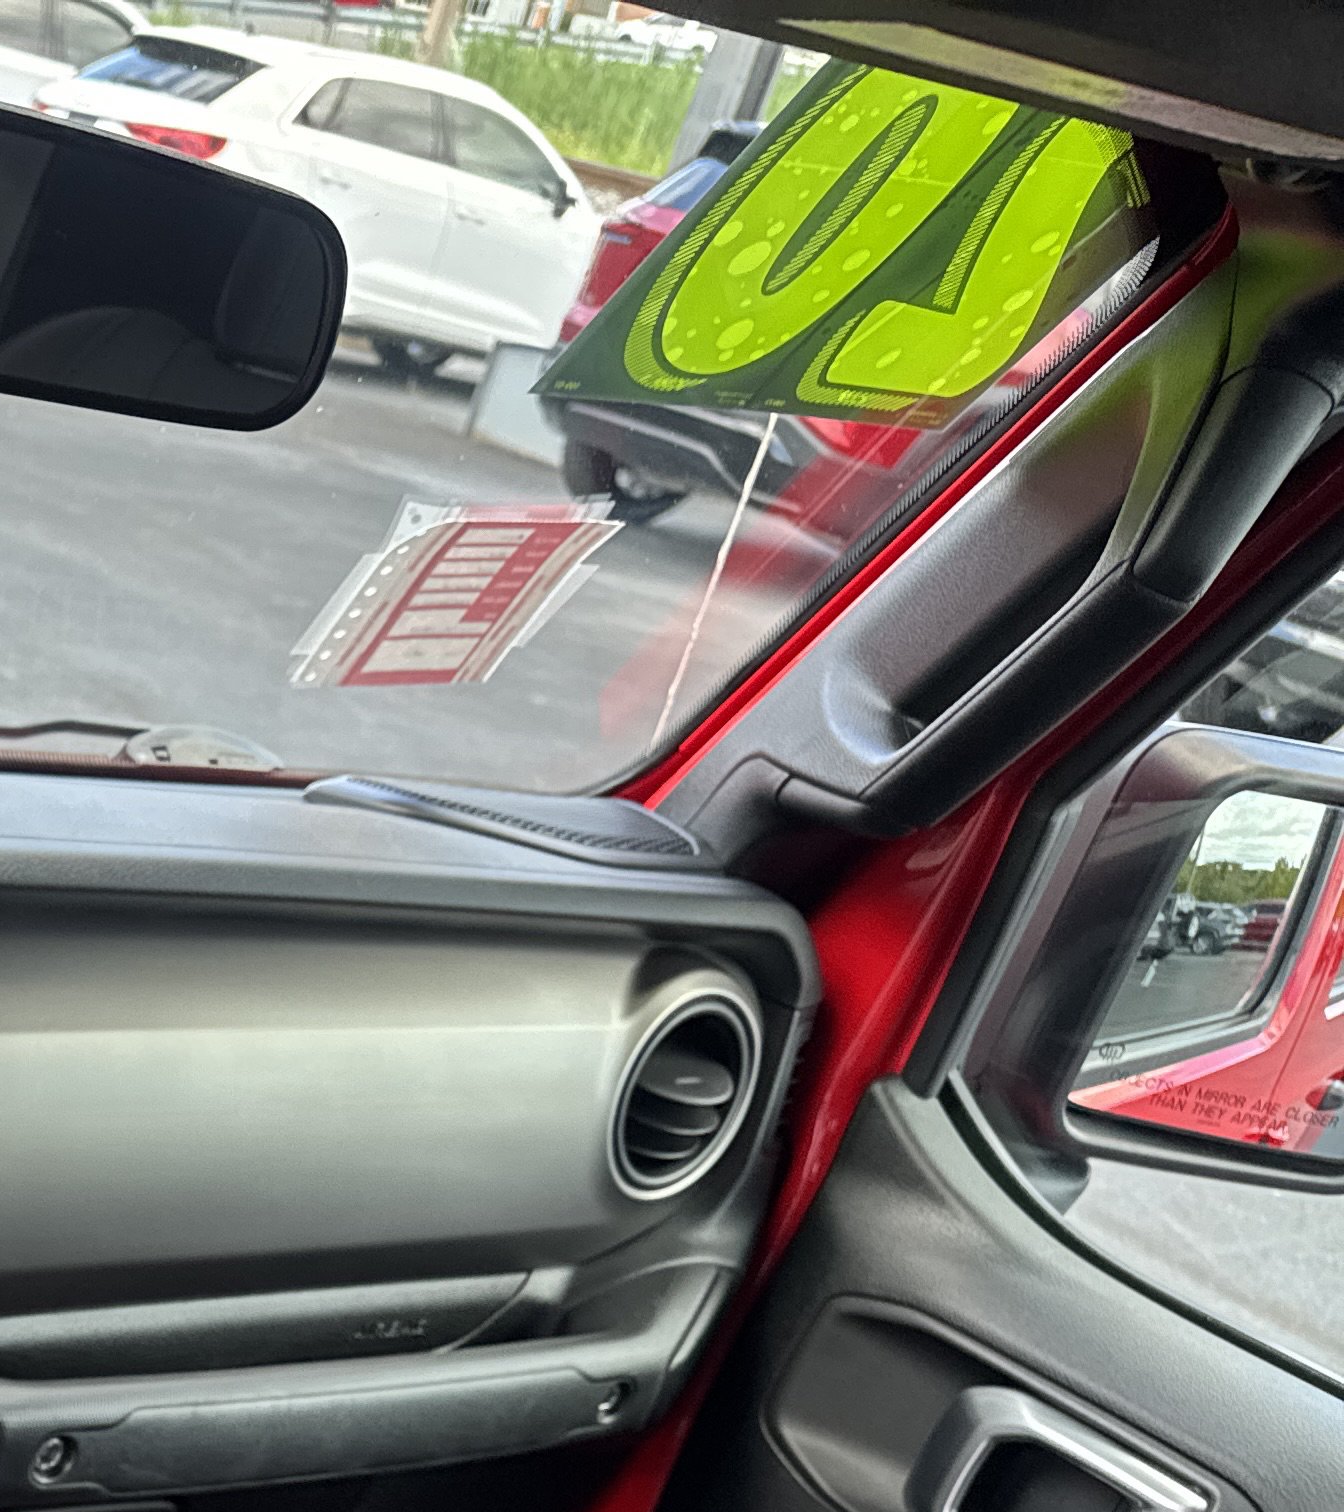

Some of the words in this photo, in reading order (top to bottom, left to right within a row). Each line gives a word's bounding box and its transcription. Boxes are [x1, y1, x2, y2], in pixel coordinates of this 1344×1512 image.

[1149, 1094, 1188, 1113] THAN
[1192, 1101, 1224, 1119] THEY
[1196, 1086, 1247, 1108] MIRROR
[1250, 1099, 1282, 1118] ARE
[1285, 1105, 1340, 1129] CLOSER
